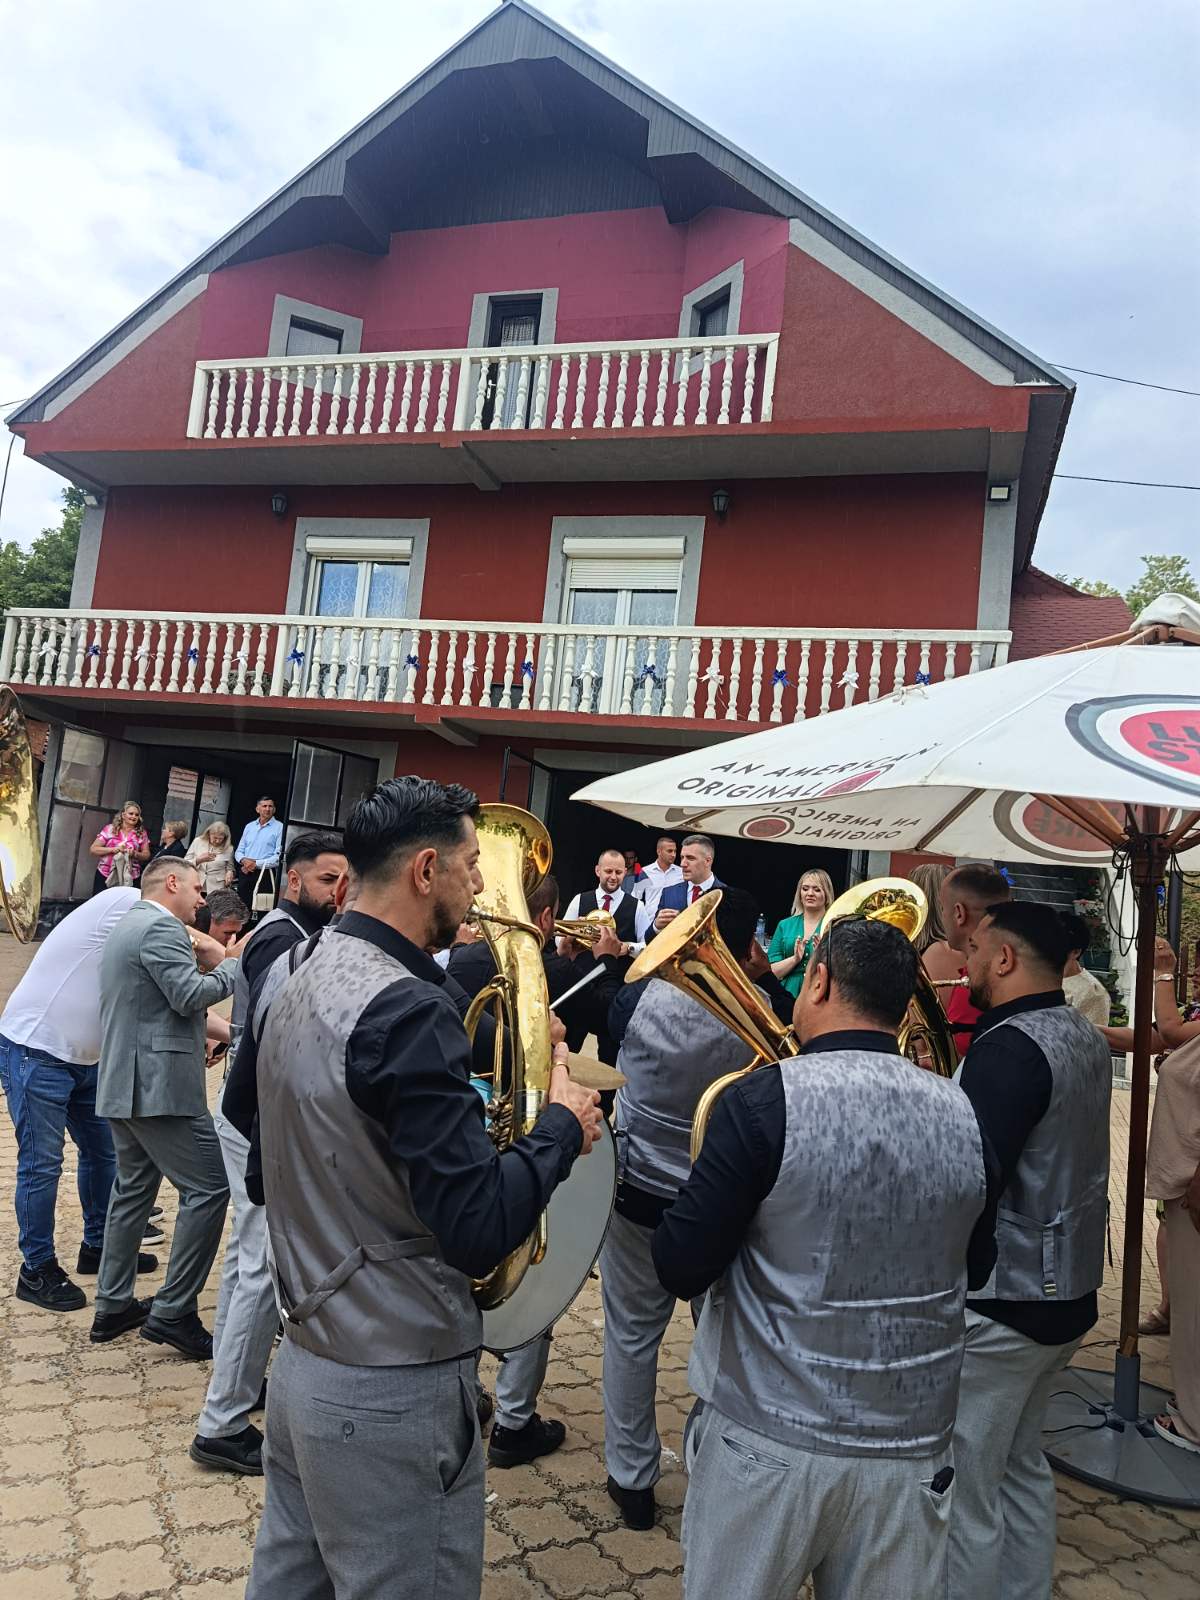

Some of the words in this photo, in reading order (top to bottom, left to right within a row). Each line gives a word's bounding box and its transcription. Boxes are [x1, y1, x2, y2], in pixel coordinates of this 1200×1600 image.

[710, 761, 765, 774] AN
[763, 743, 942, 777] AMERICAN
[677, 777, 823, 798] ORIGINAL
